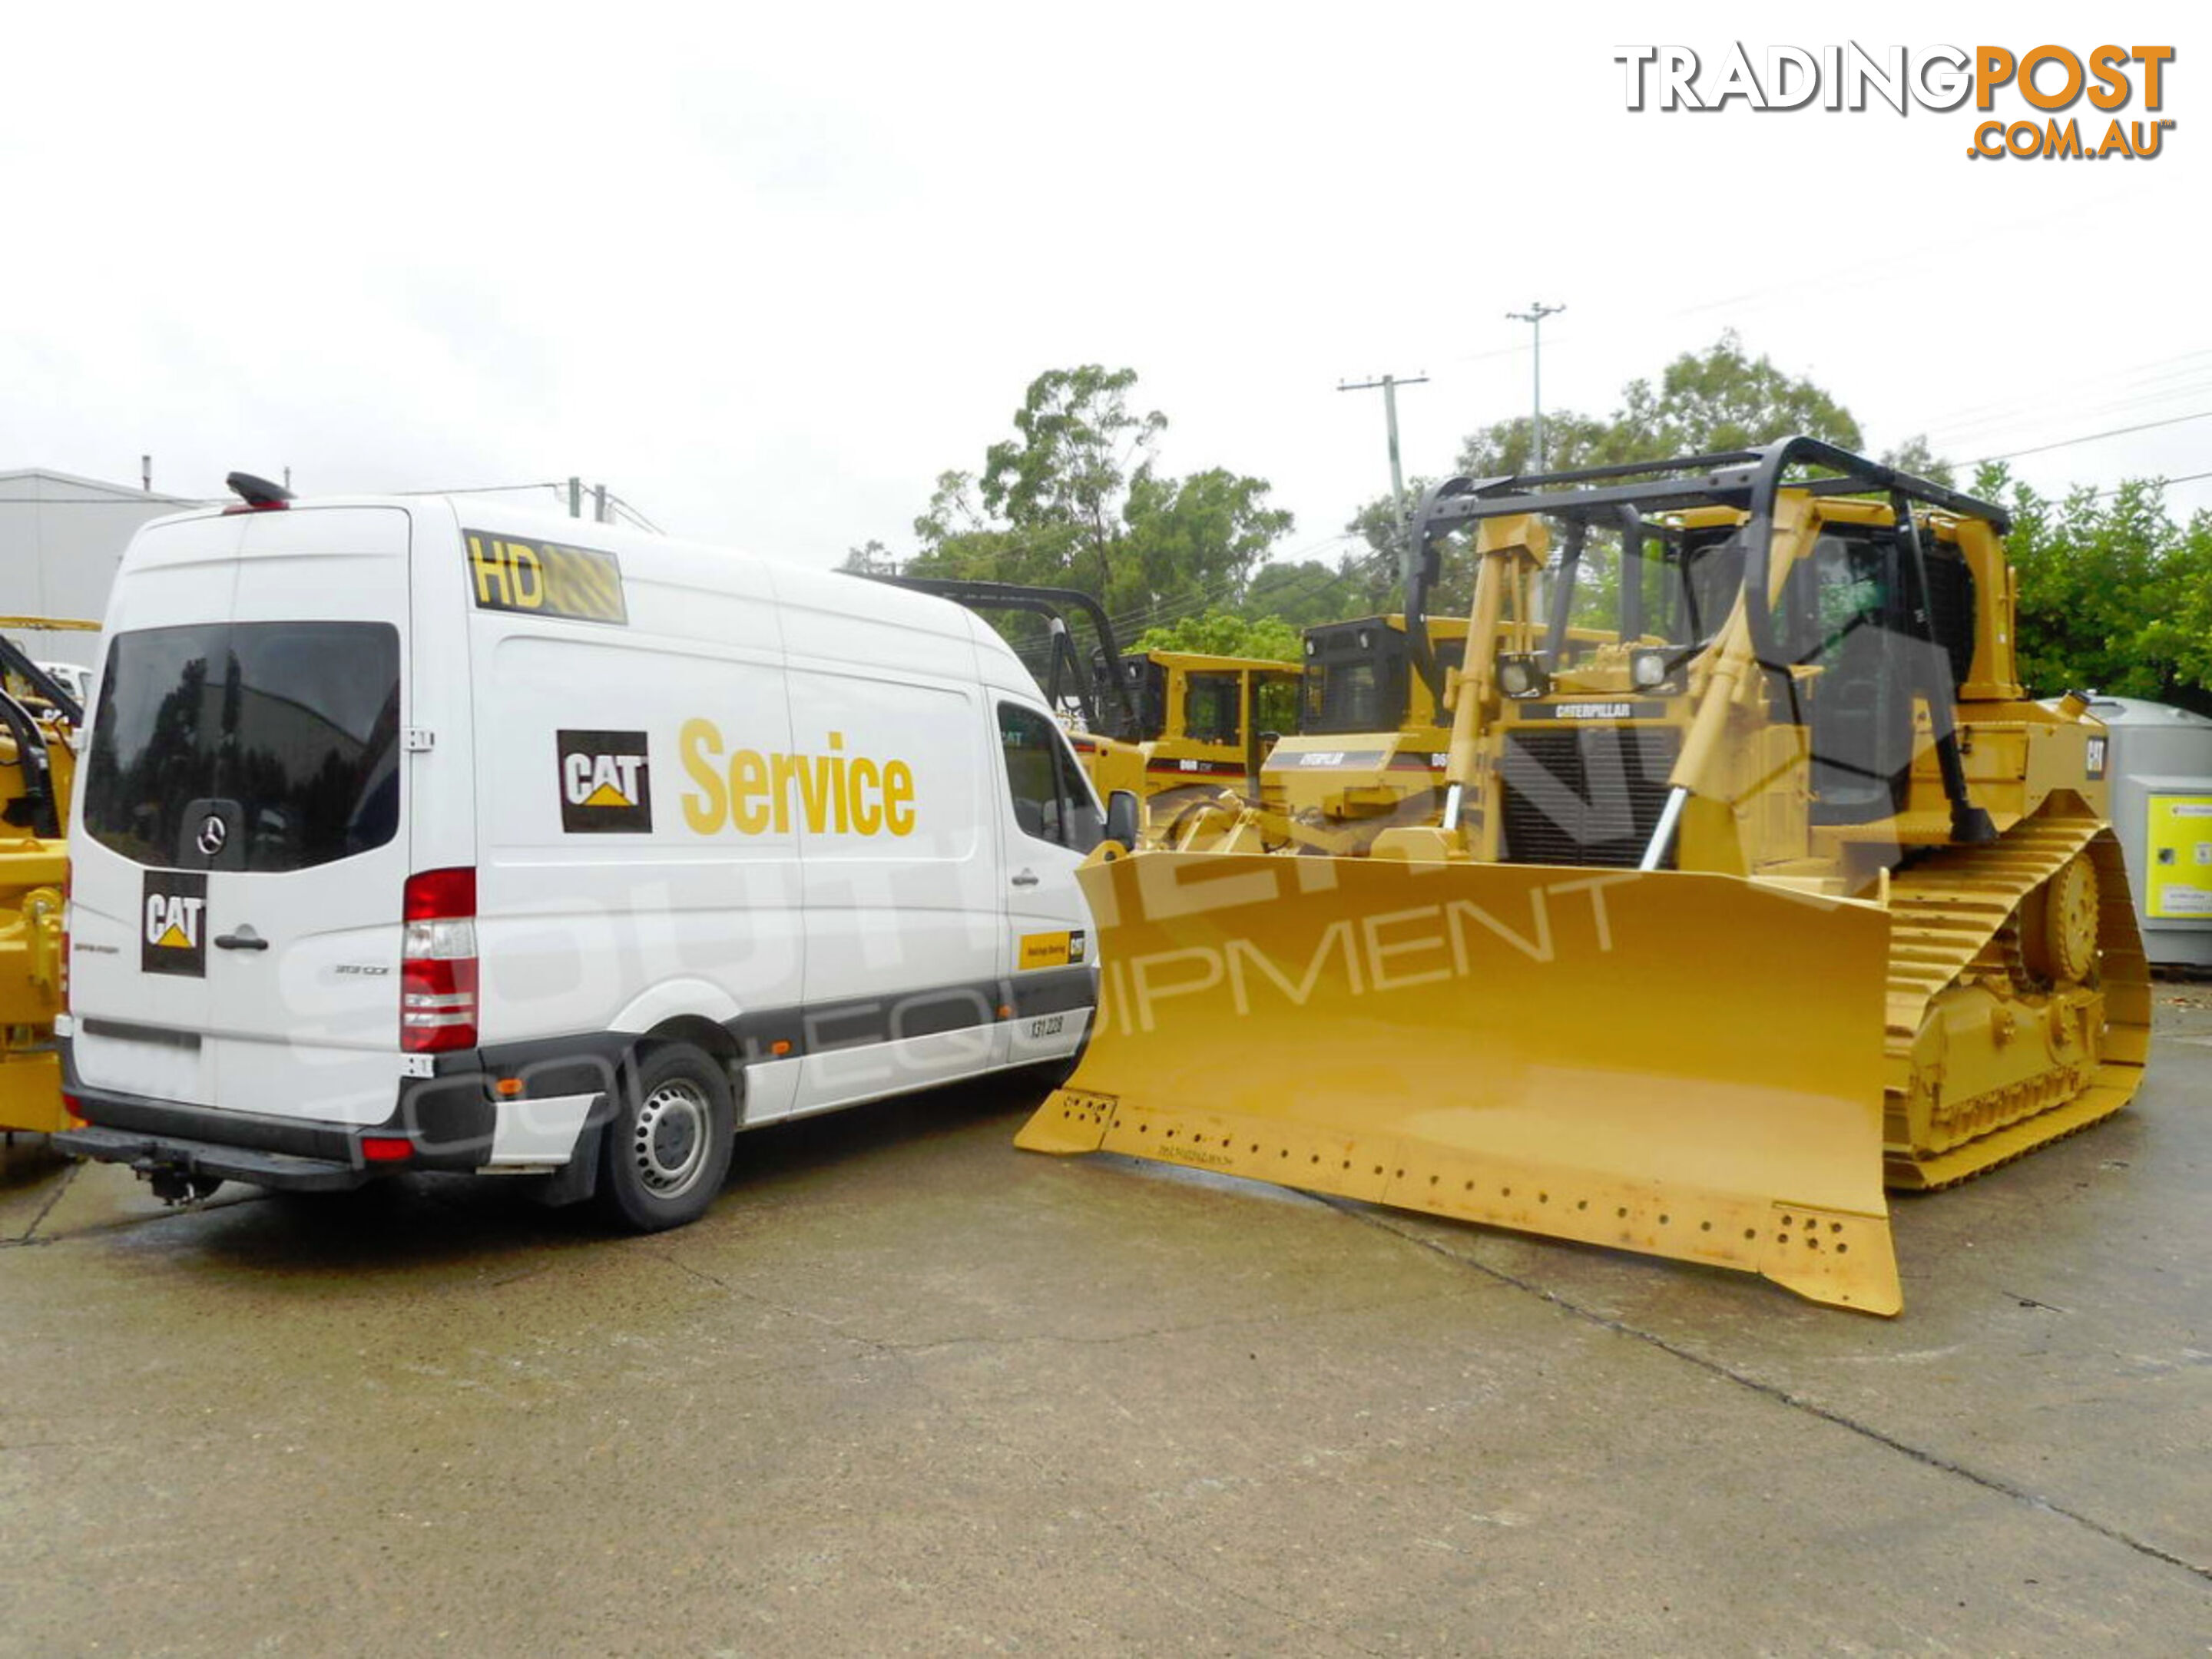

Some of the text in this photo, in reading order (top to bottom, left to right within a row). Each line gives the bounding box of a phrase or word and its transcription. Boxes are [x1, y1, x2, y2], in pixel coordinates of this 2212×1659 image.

[469, 536, 545, 608] HD
[1555, 703, 1630, 718] CATERPILLAR
[564, 753, 647, 806] CAT
[679, 717, 917, 837] Service
[147, 892, 206, 949] CAT
